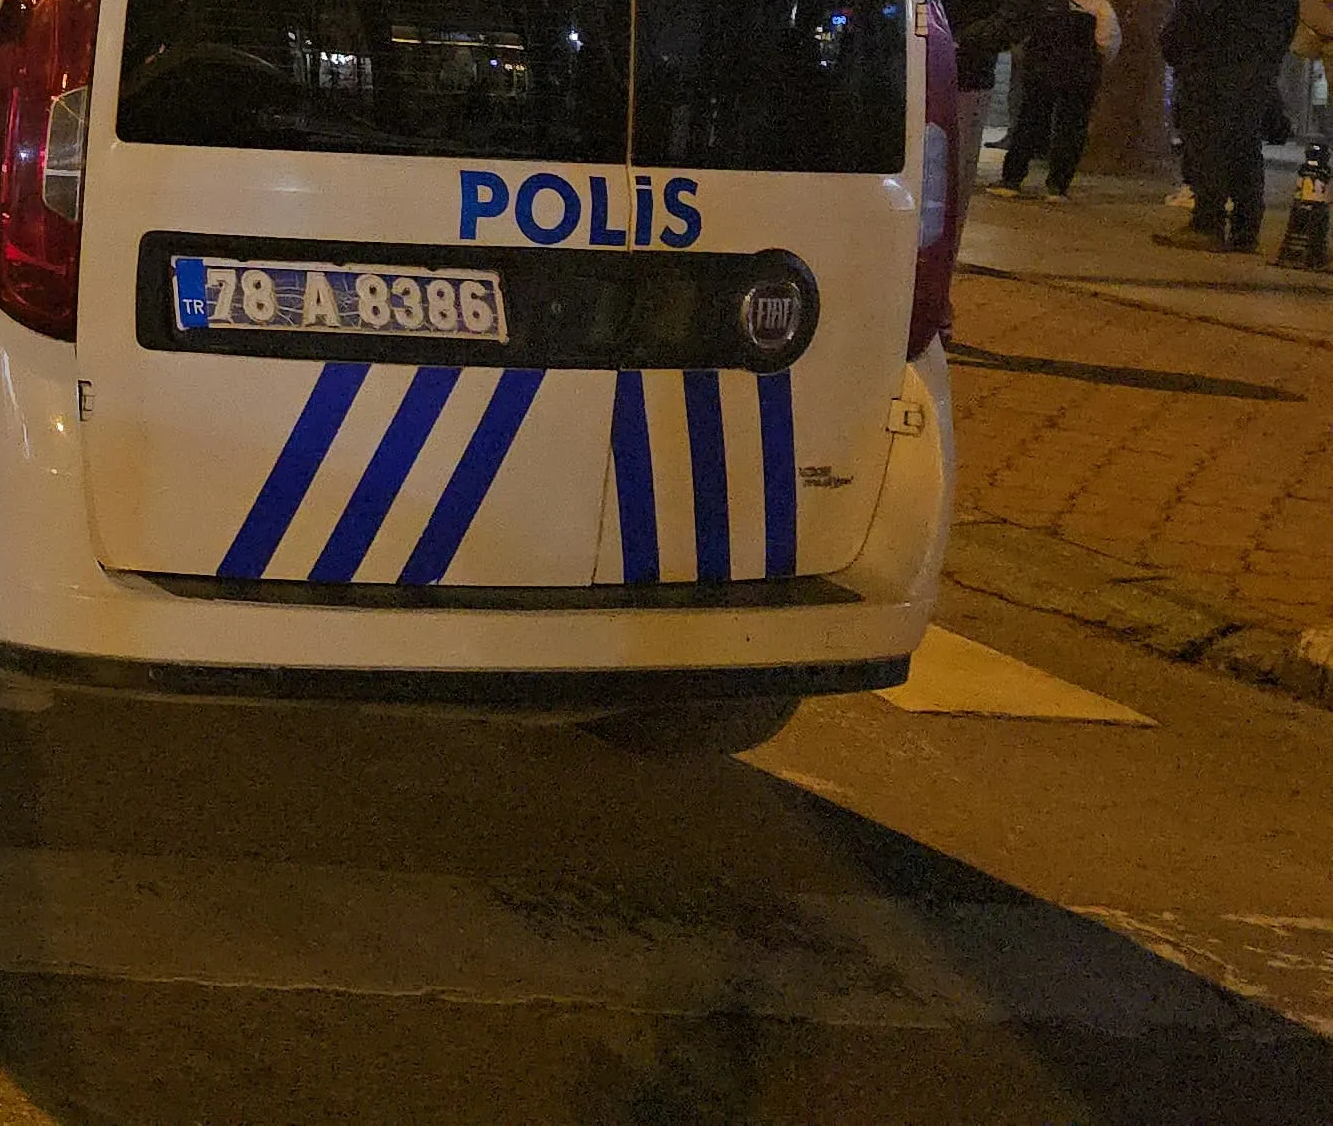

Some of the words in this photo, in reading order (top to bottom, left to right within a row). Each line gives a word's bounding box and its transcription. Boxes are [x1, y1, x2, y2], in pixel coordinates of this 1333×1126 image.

[183, 298, 205, 315] TR
[207, 267, 276, 323] 78
[302, 271, 341, 327] A
[756, 297, 792, 330] FIAT
